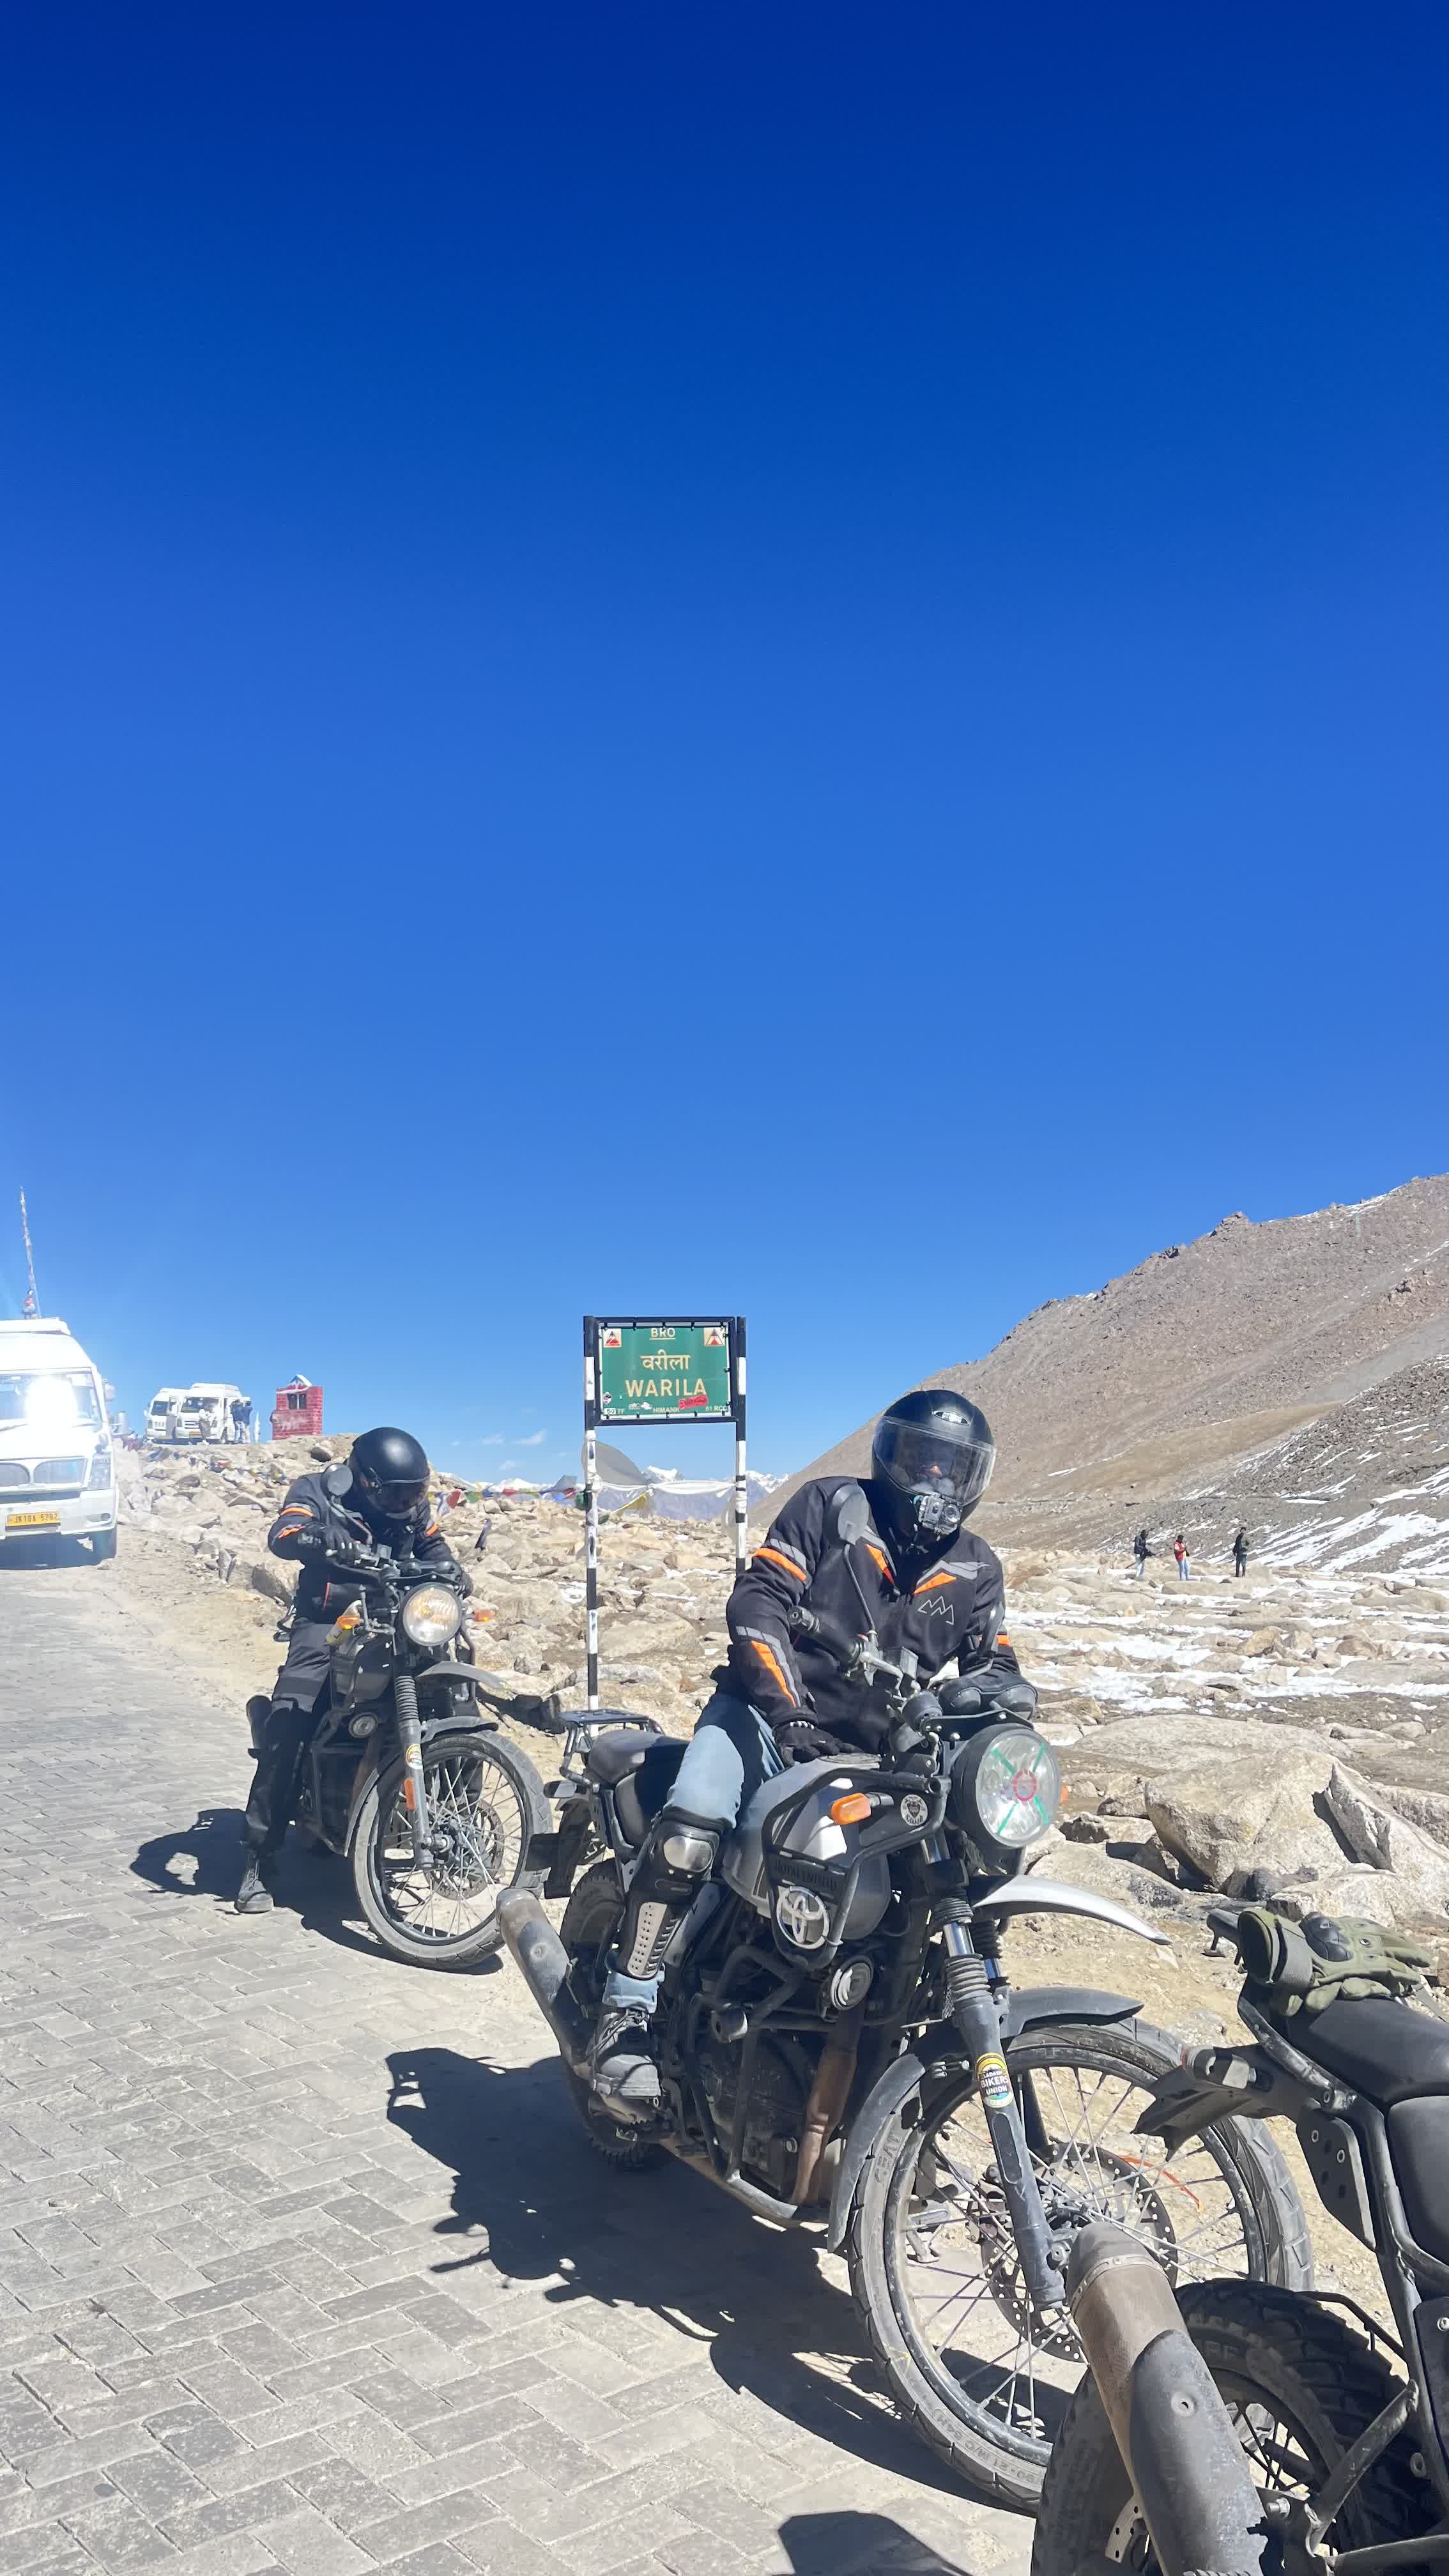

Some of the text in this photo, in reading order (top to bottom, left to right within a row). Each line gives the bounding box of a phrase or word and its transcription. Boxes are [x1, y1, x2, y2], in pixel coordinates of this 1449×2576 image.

[650, 1328, 676, 1338] BRO
[640, 1349, 691, 1370] वरीला
[625, 1378, 707, 1397] WARILA
[980, 2074, 1009, 2089] BIKERS
[986, 2085, 1008, 2096] UNION
[874, 2130, 900, 2183] CEAT
